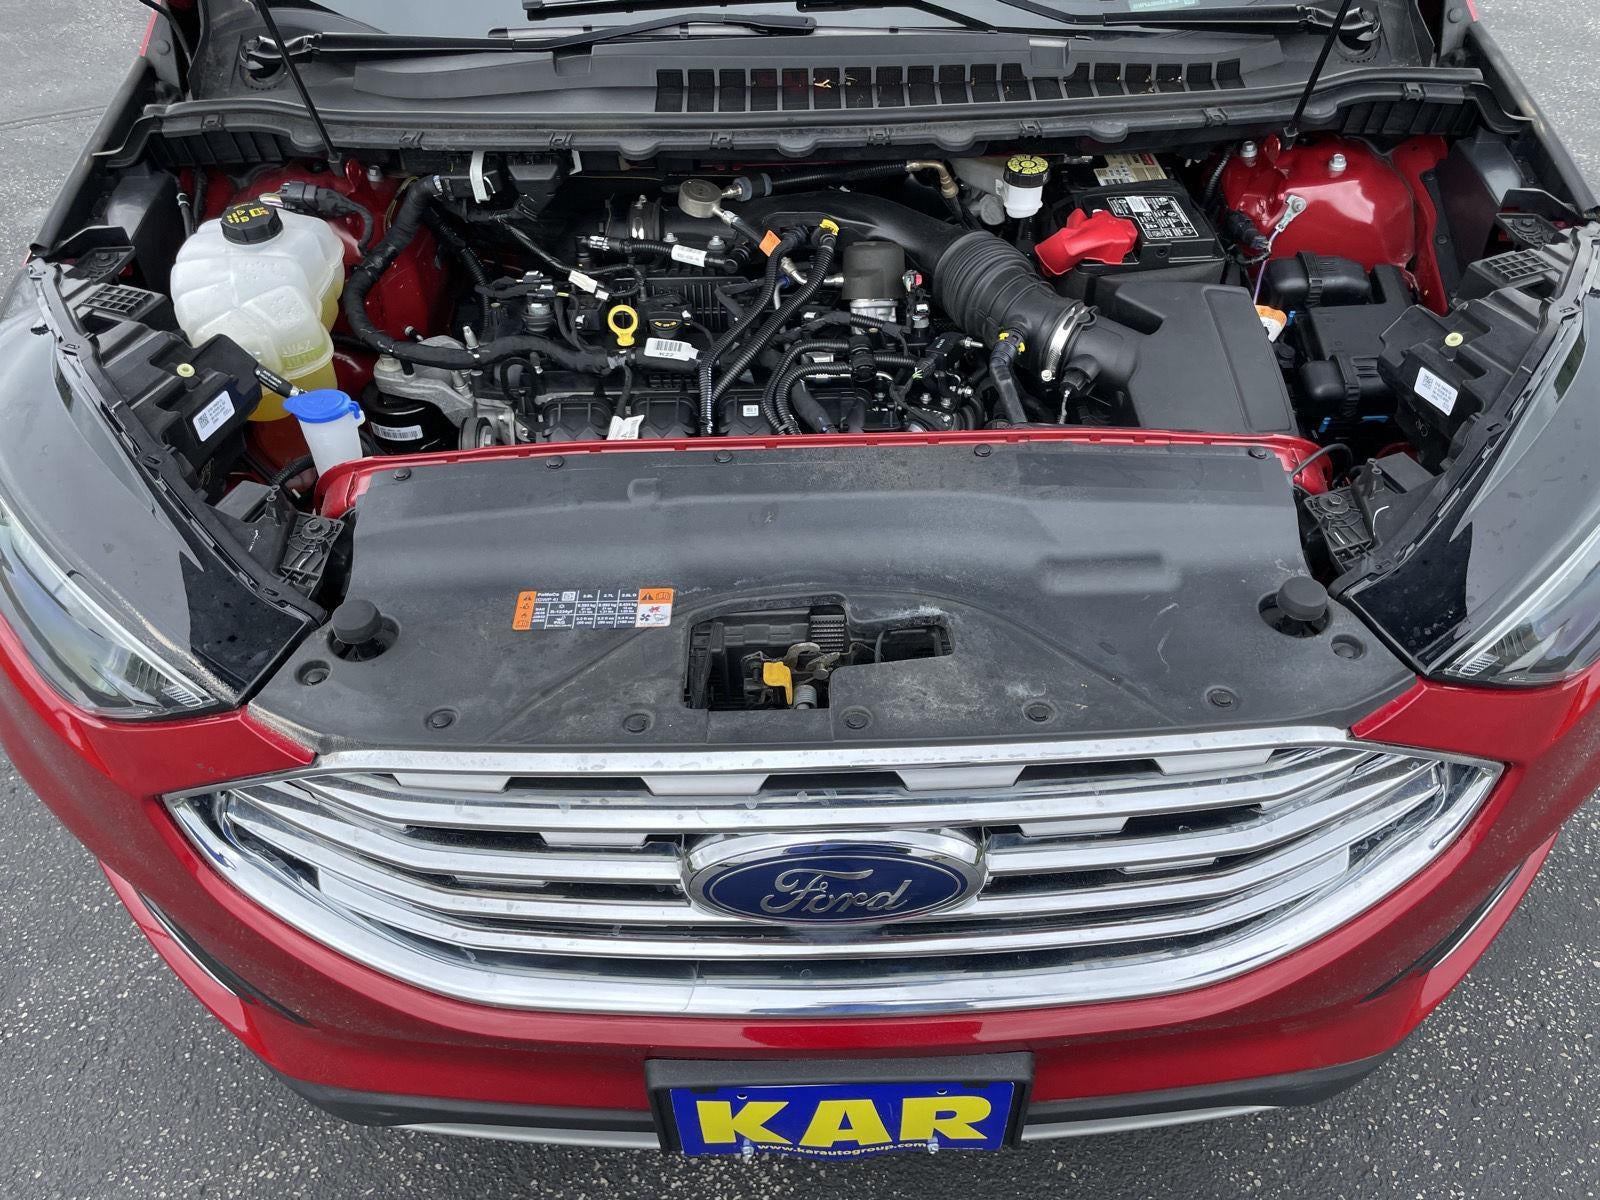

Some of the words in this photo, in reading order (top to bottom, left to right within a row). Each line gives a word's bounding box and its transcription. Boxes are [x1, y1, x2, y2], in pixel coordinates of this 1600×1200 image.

[759, 868, 912, 914] Ford
[696, 1095, 992, 1148] KAR
[757, 1142, 927, 1156] www.karautogroup.com
